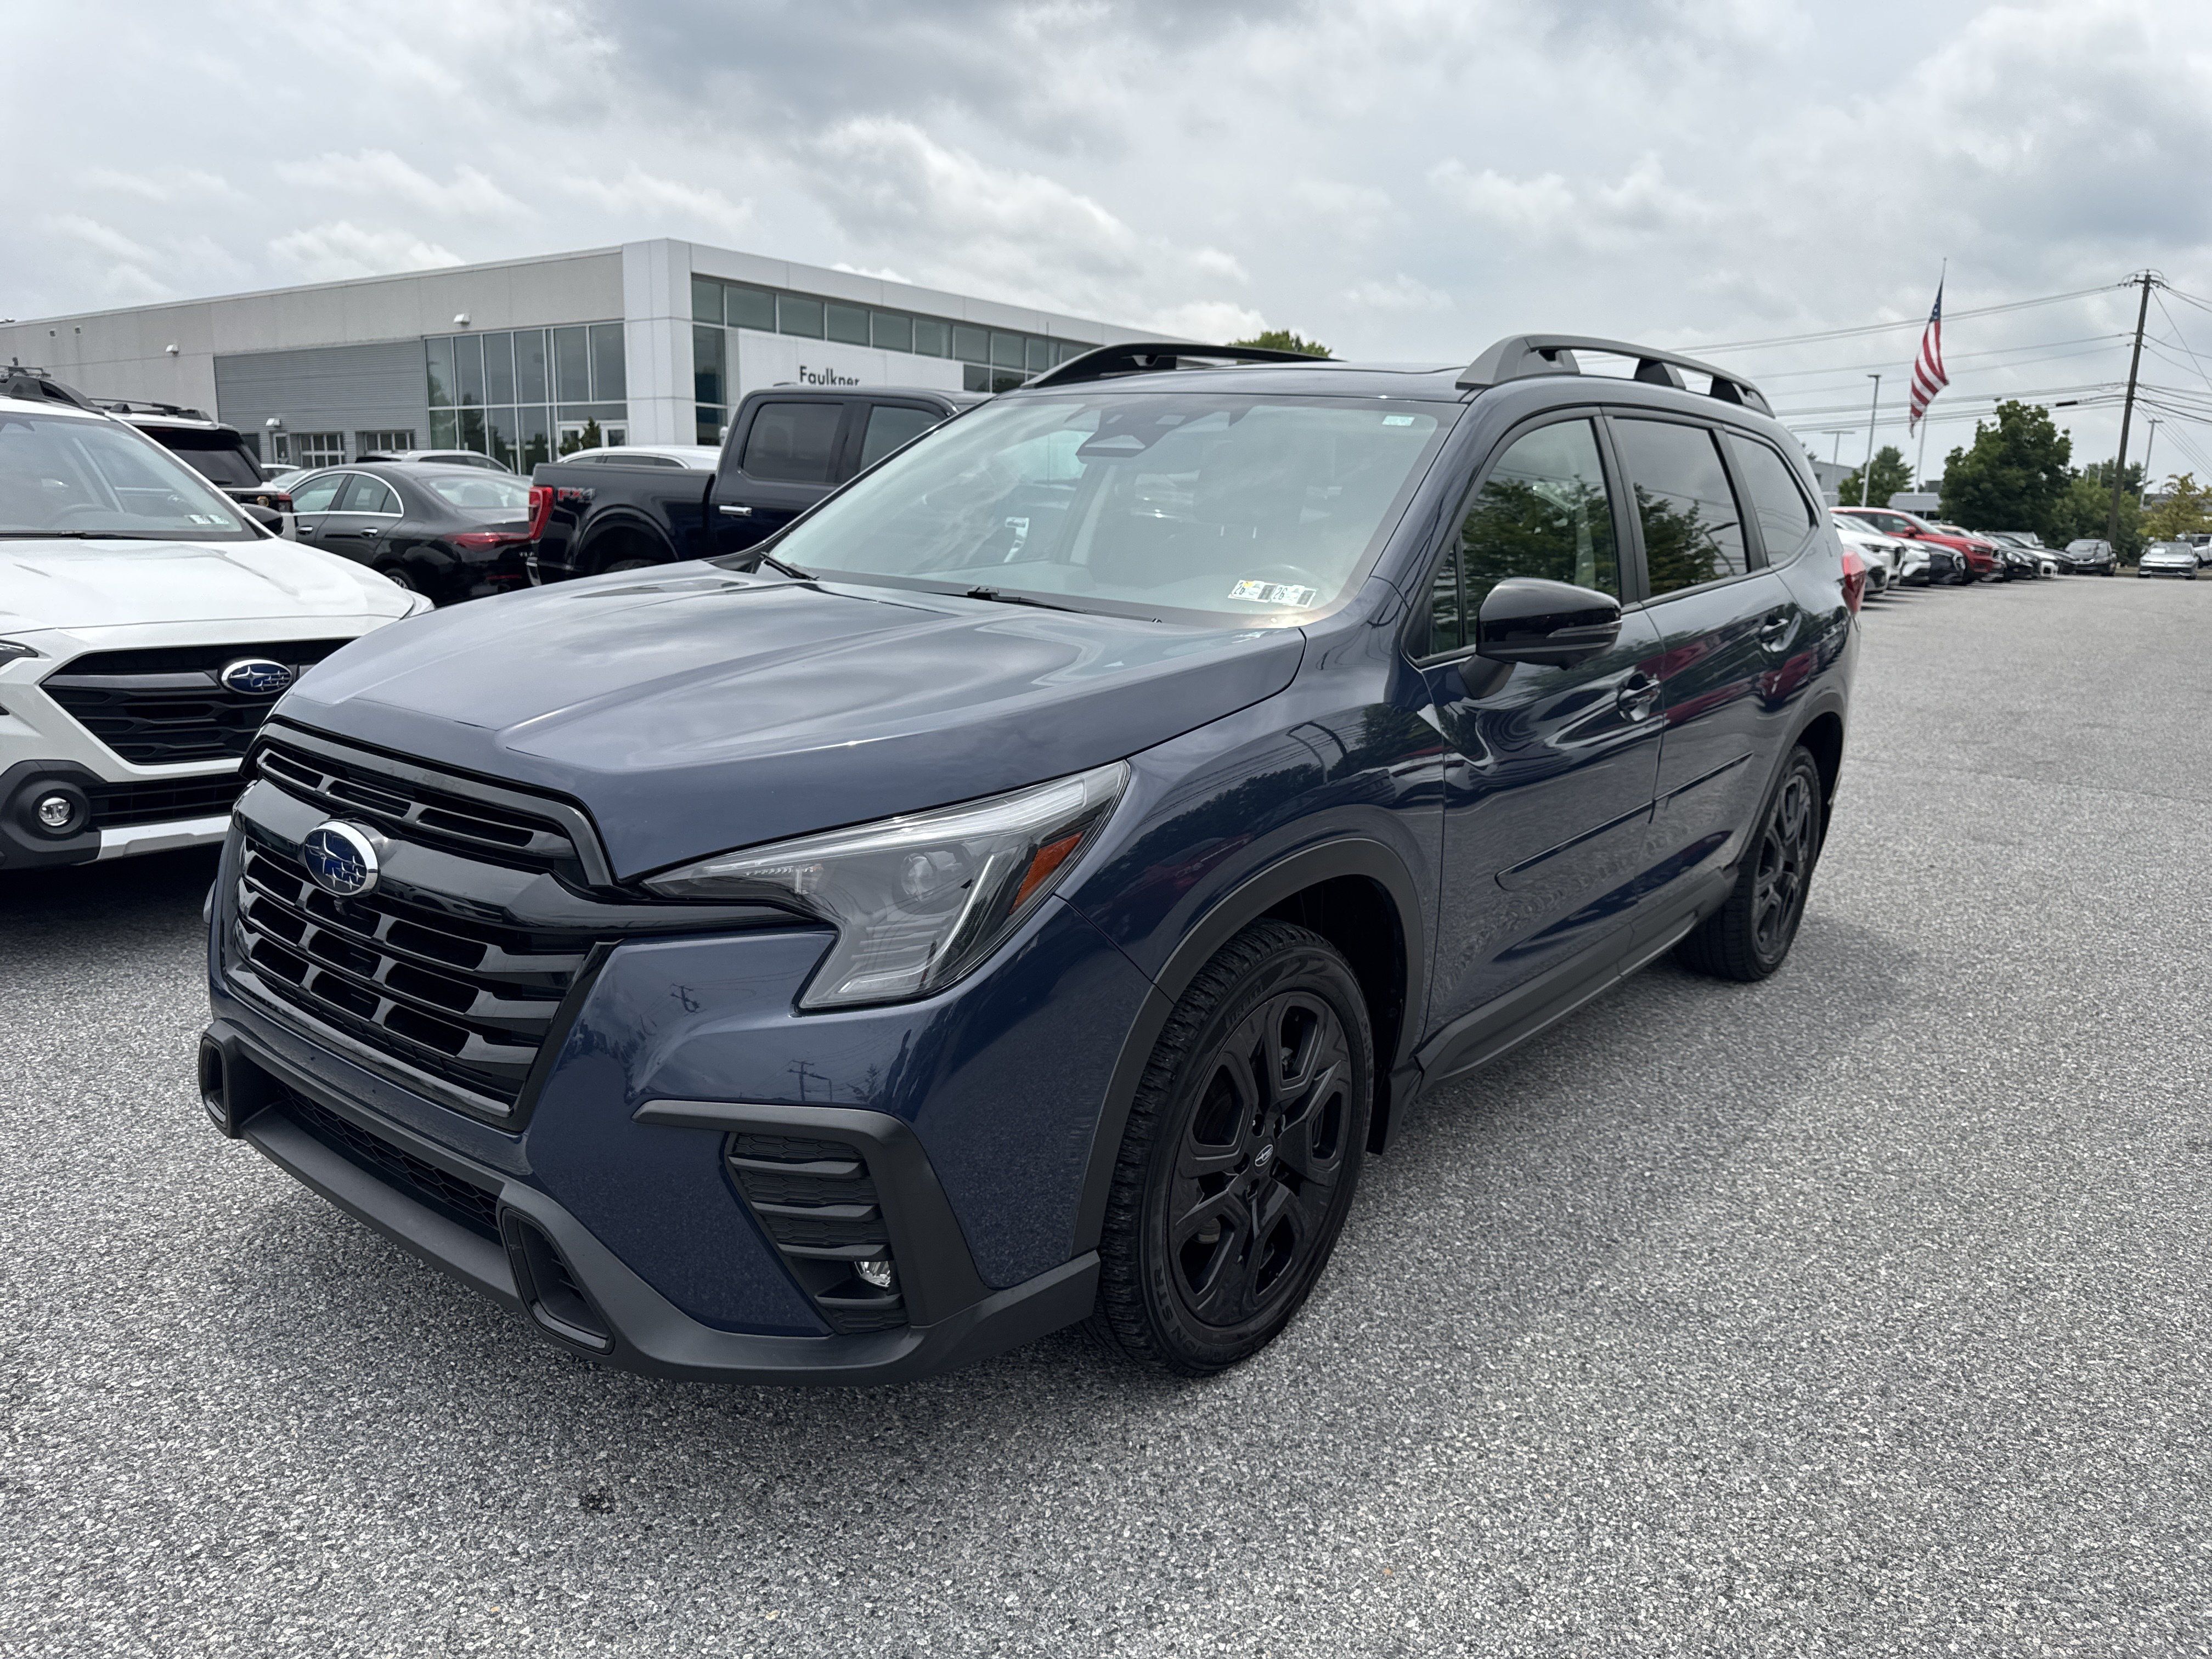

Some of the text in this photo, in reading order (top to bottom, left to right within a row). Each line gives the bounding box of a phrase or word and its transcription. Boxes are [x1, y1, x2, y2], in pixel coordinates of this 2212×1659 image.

[799, 365, 860, 385] Faulkner
[557, 487, 595, 501] FX4
[1272, 586, 1288, 600] 26
[1154, 1265, 1174, 1323] STR
